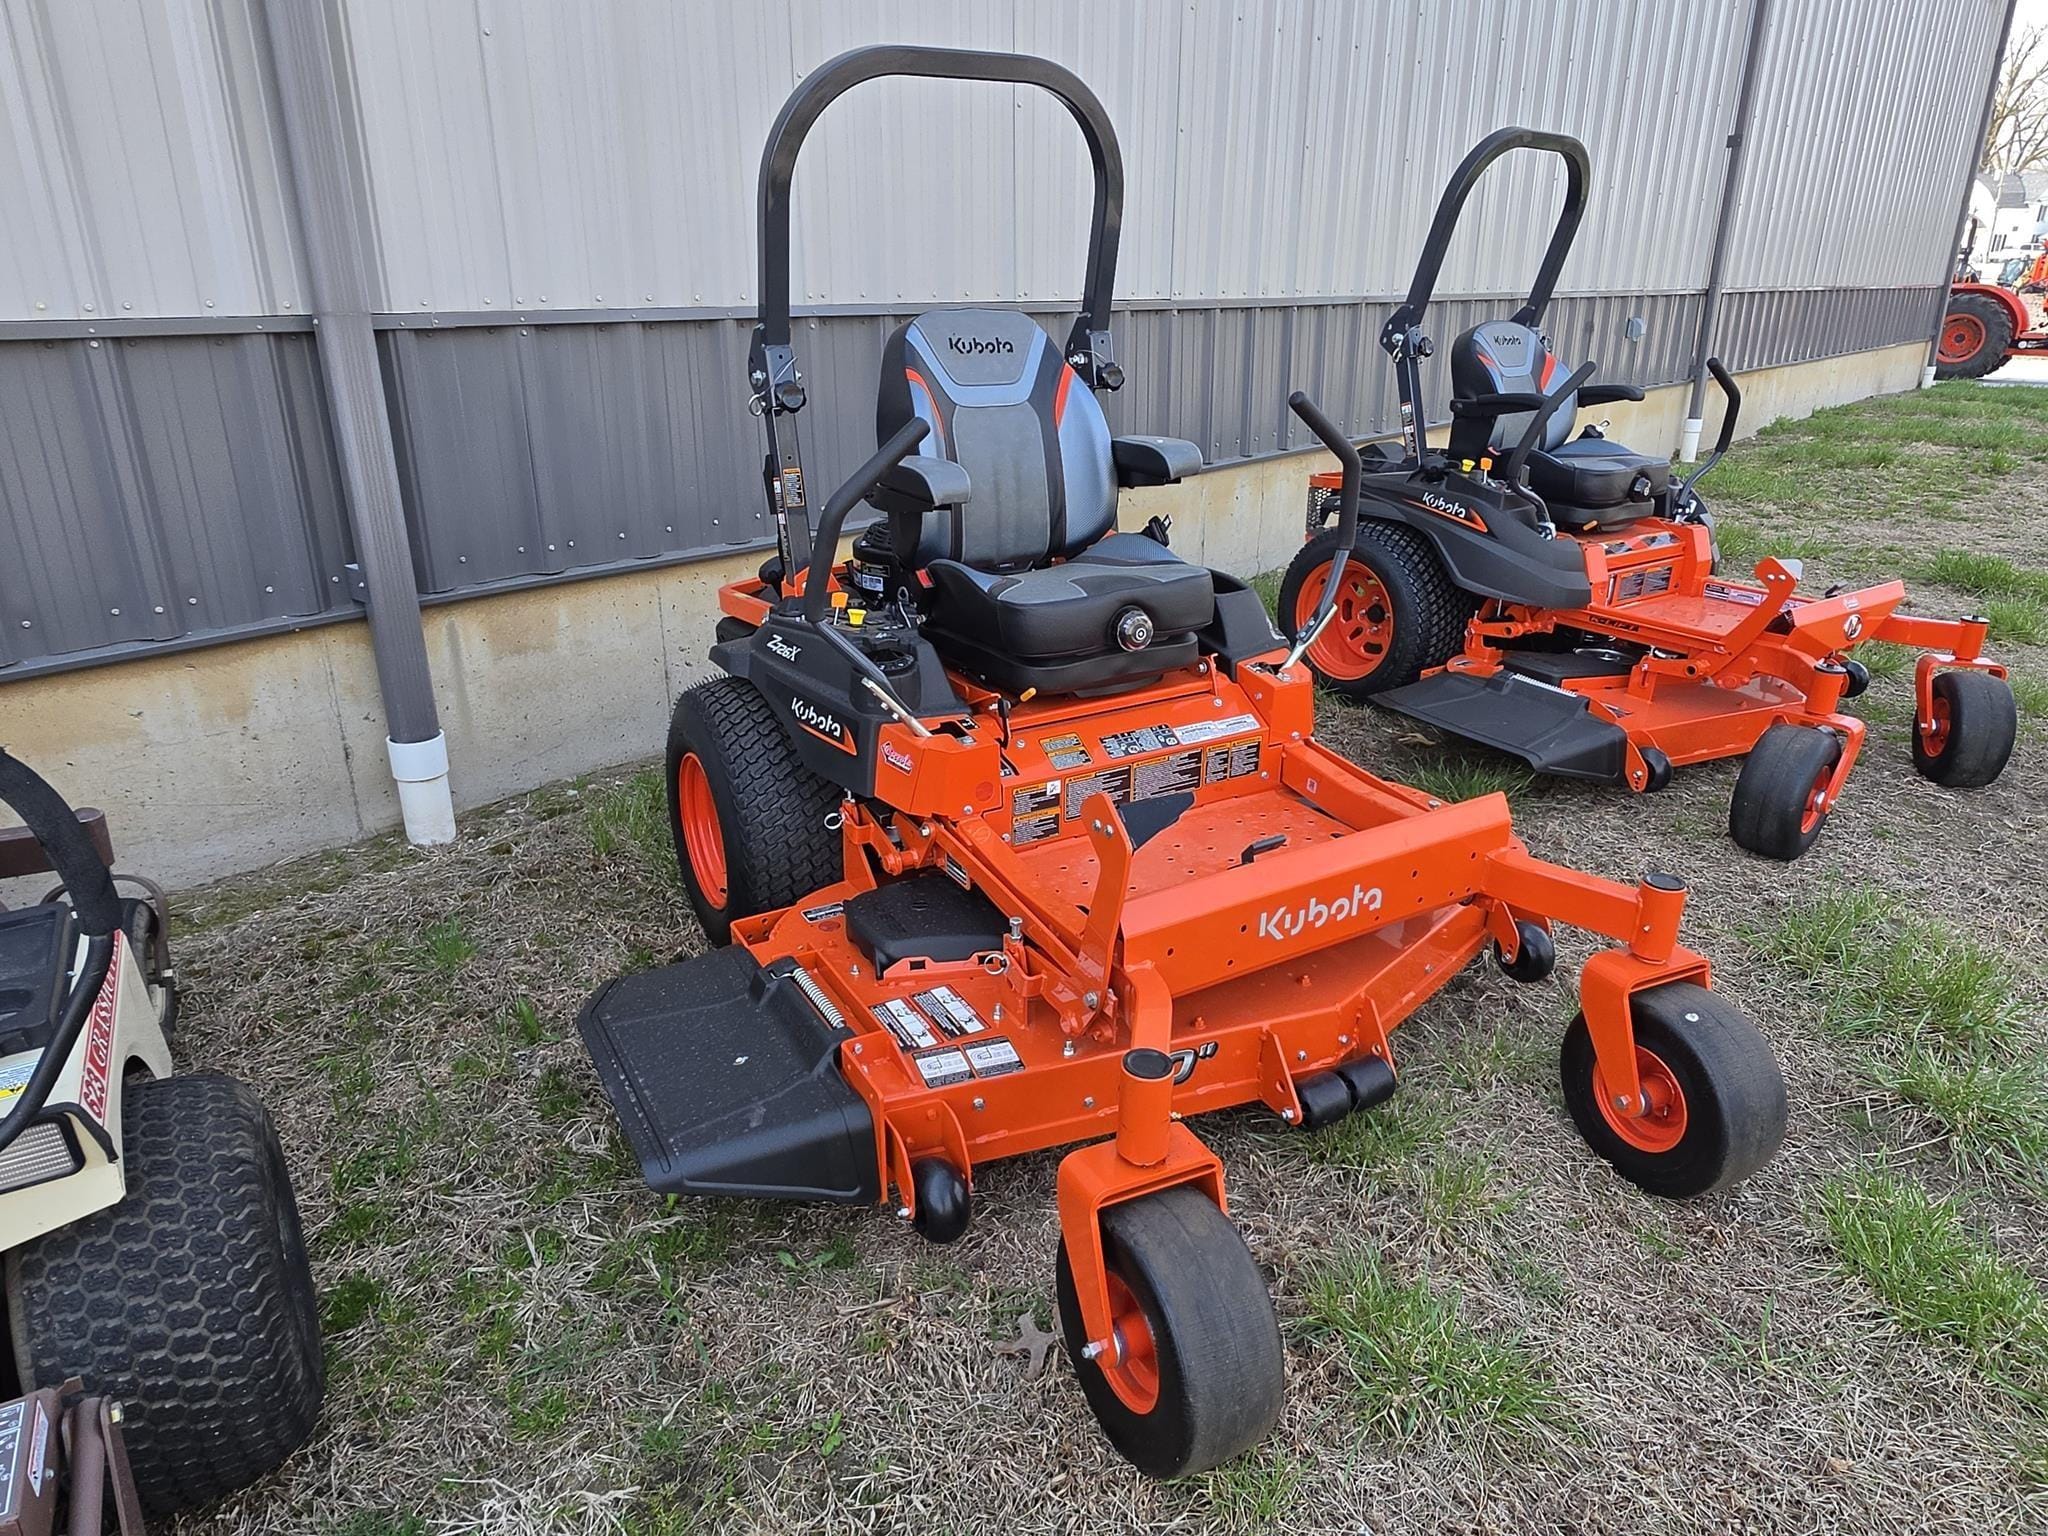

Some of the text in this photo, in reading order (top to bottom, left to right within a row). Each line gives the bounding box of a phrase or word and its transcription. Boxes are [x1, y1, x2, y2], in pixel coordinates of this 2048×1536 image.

[948, 336, 1014, 354] Kubota
[1422, 491, 1466, 518] Kubota
[766, 634, 803, 662] Z726X
[791, 697, 841, 737] Kubota
[1258, 884, 1383, 940] Kubota
[84, 1066, 105, 1119] 623
